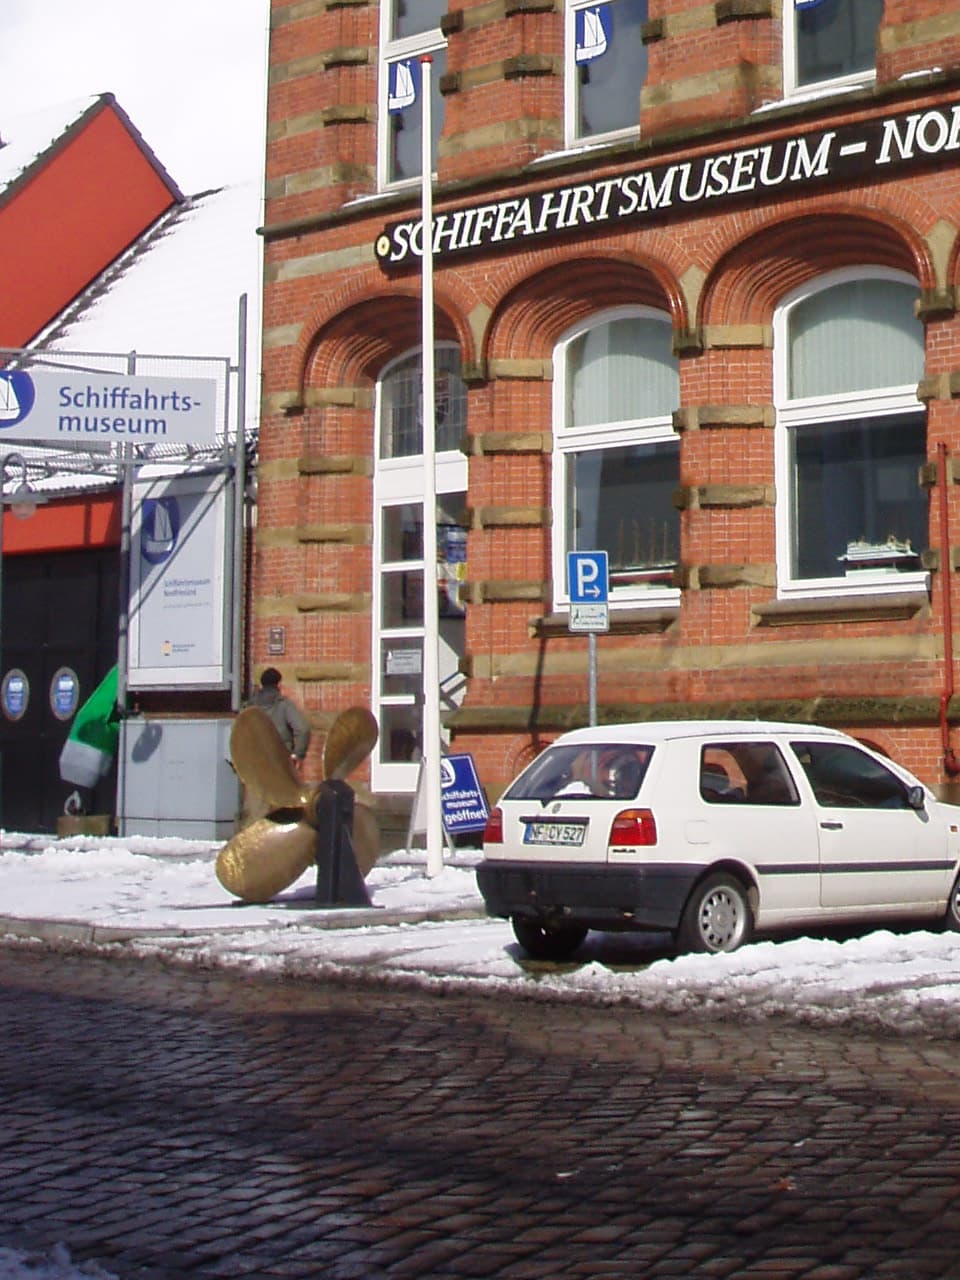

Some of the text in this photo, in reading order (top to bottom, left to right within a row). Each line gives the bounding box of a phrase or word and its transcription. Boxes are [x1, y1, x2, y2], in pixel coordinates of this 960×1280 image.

[390, 132, 836, 262] SCHIFFAHRTSMUSEUM
[58, 385, 201, 412] Schiffahrts-
[58, 413, 167, 435] museum
[576, 558, 600, 598] P
